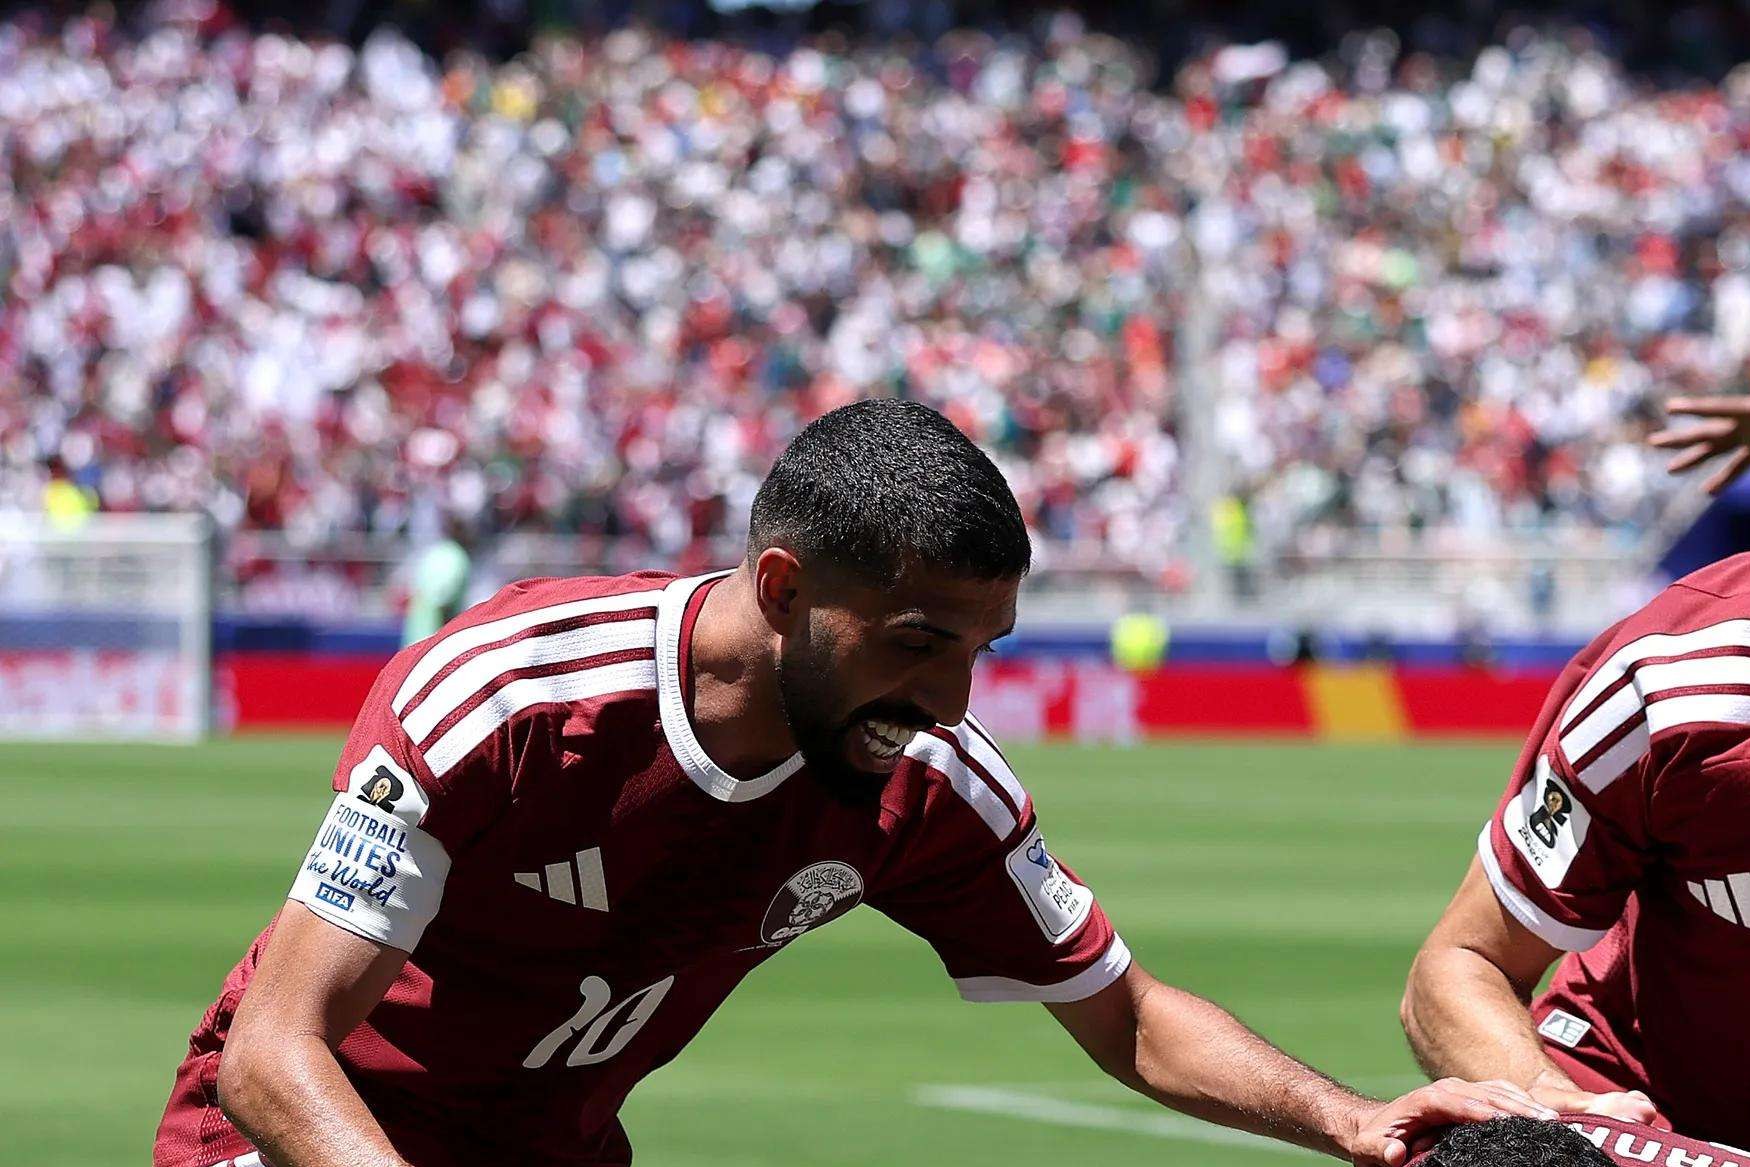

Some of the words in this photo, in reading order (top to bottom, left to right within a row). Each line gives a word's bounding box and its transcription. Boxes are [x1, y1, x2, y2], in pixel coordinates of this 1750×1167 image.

[320, 825, 401, 878] UNITES
[335, 803, 408, 853] FOOTBALL
[306, 851, 329, 875] the
[330, 860, 397, 907] World
[317, 885, 351, 909] FIFA
[522, 975, 675, 1068] 10
